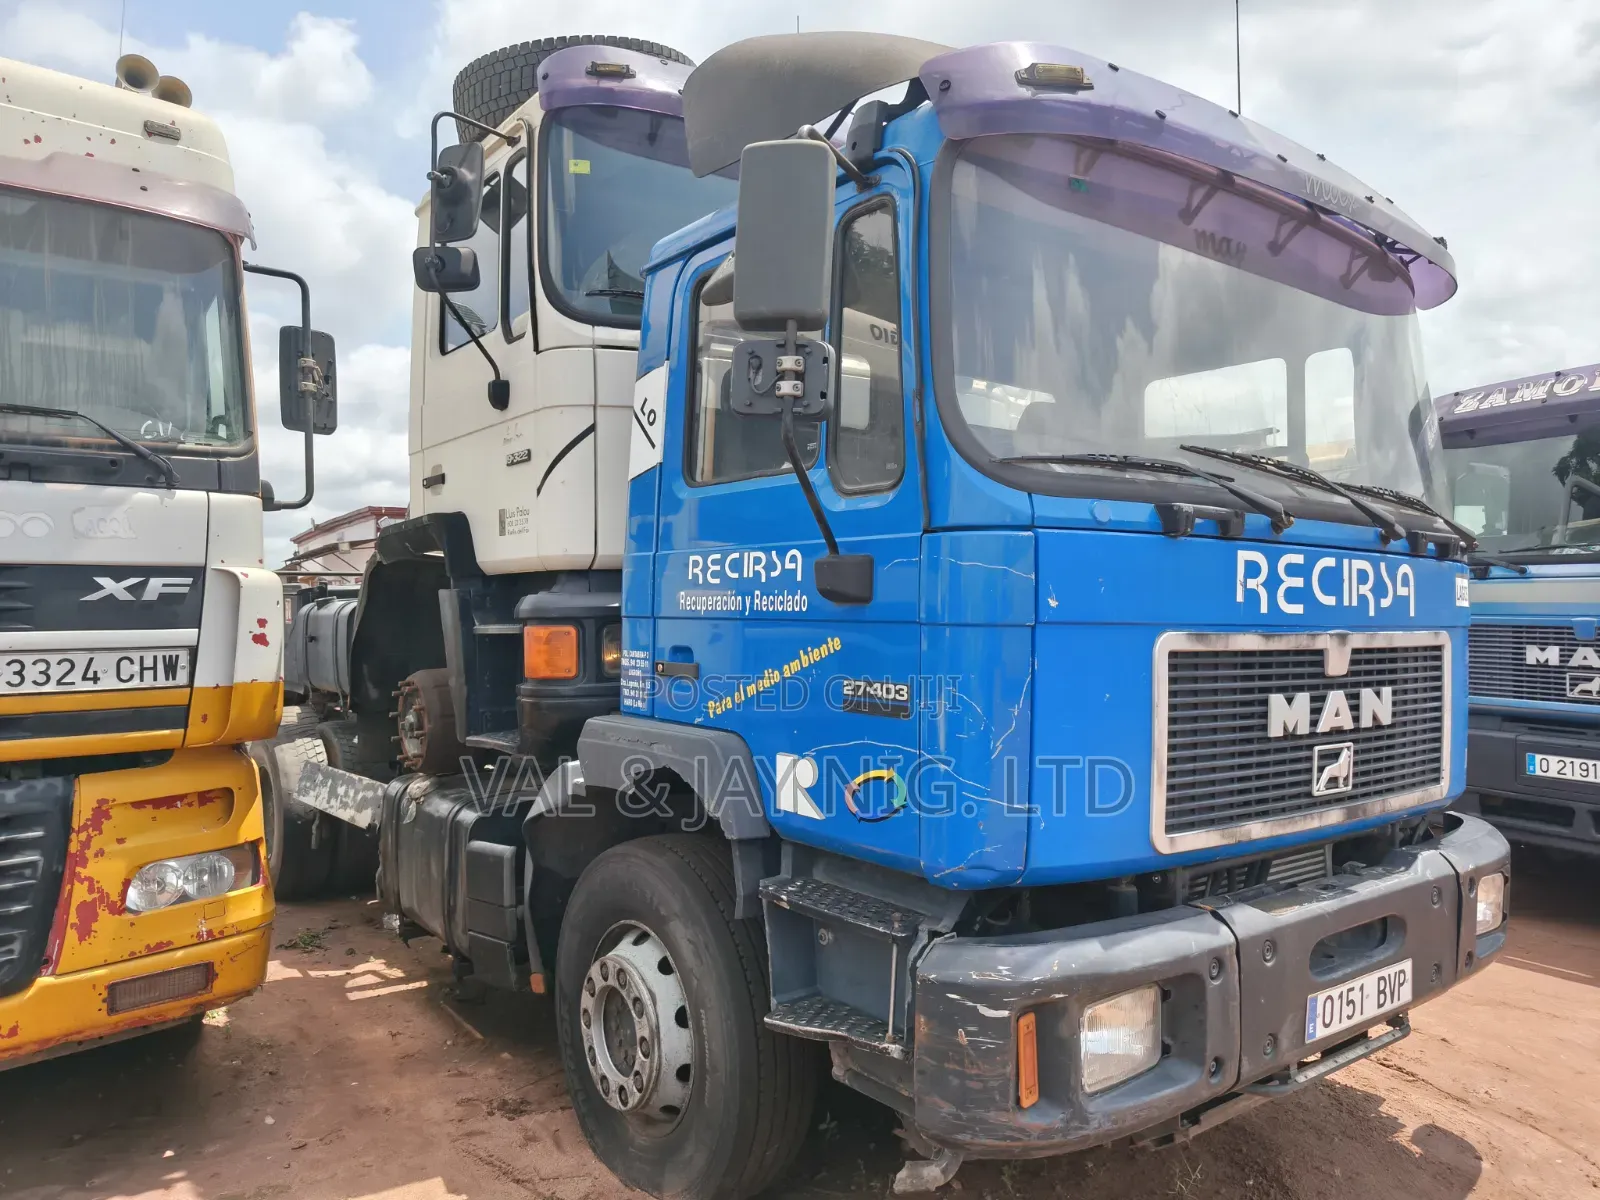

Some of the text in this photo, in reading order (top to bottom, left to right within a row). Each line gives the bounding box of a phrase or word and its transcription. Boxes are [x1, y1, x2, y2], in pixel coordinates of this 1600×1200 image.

[688, 548, 803, 585] RECIRSA
[1236, 550, 1415, 617] RECIRSA
[79, 576, 194, 600] XF
[679, 590, 808, 616] Recuperación y Reciclado
[5, 654, 180, 688] 3324 CHW
[707, 637, 842, 718] Para el medio ambiente
[1267, 686, 1393, 738] MAN
[1556, 759, 1598, 780] 2191
[1322, 968, 1407, 1029] 0151 BVP
